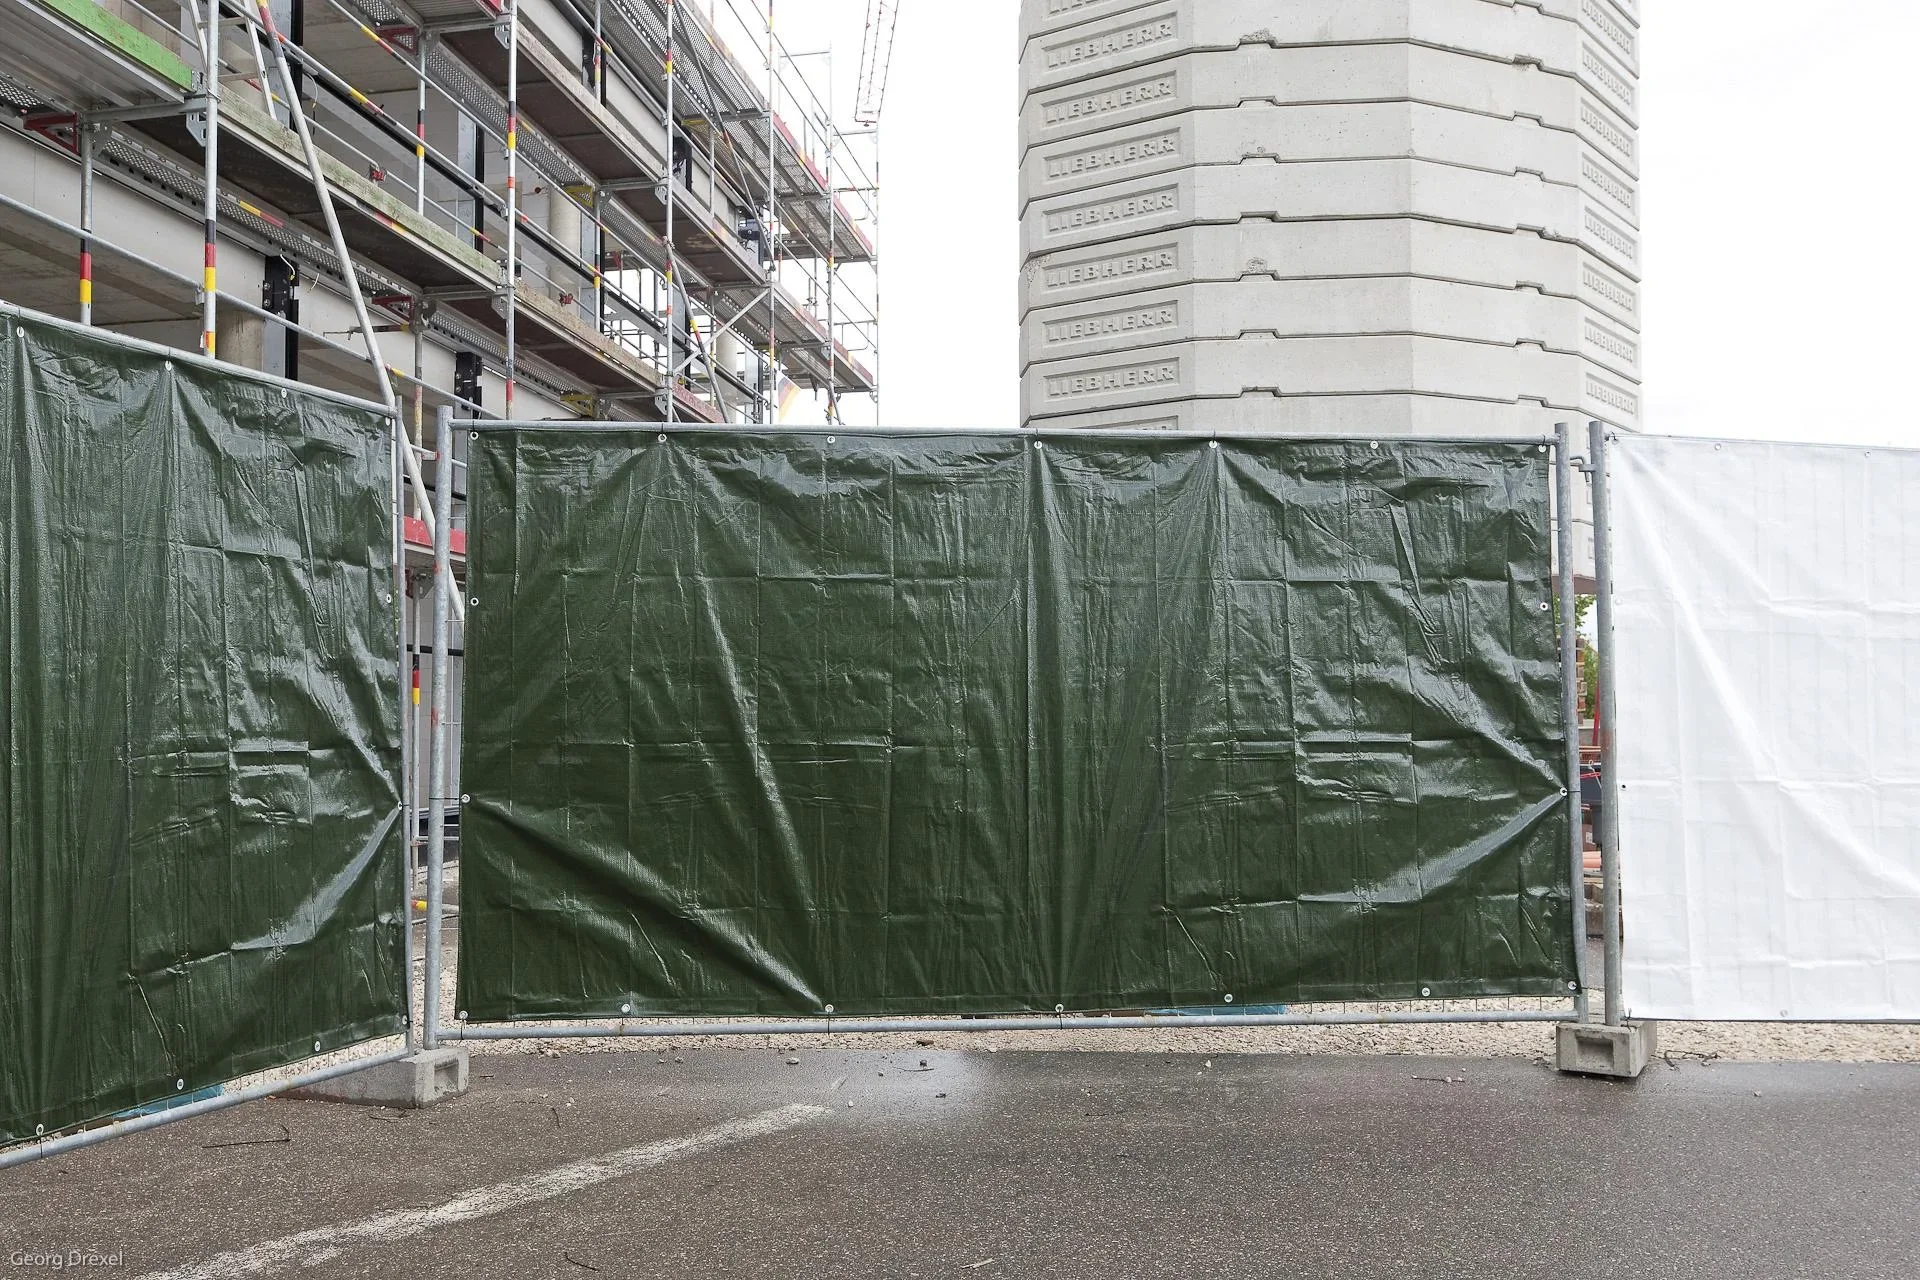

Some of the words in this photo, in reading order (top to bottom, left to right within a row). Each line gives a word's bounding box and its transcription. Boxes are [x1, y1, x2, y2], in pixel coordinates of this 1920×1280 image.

[1048, 22, 1172, 68] LIEBHERR
[1047, 81, 1171, 124] LIEBHERR
[1050, 138, 1175, 177] LIEBHERR
[1049, 194, 1174, 232] LIEBHERR
[1047, 252, 1172, 287] LIEBHERR
[1049, 309, 1173, 341] LIEBHERR
[1050, 366, 1175, 396] LIEBHERR
